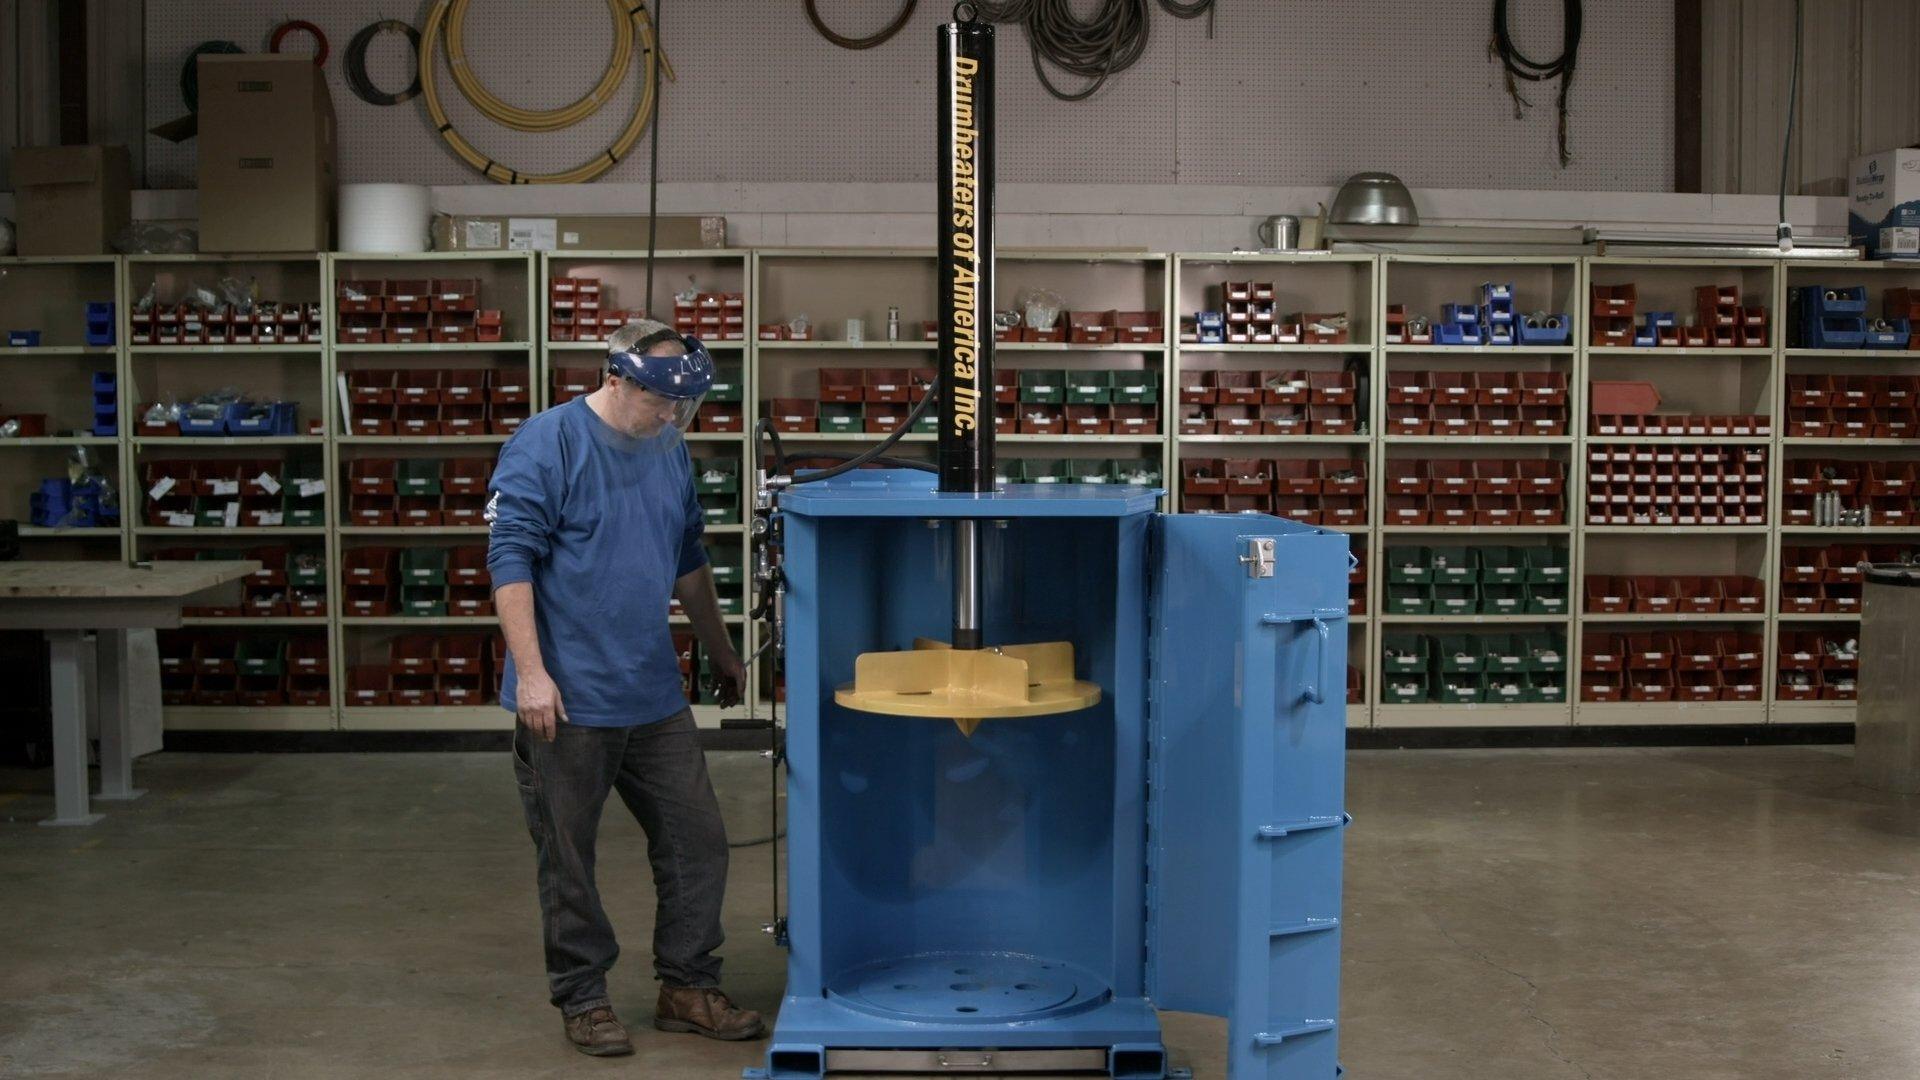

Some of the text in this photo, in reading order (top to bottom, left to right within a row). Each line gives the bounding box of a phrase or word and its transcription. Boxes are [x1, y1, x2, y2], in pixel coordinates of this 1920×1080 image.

[953, 56, 980, 437] Drumbeaters of America Inc.
